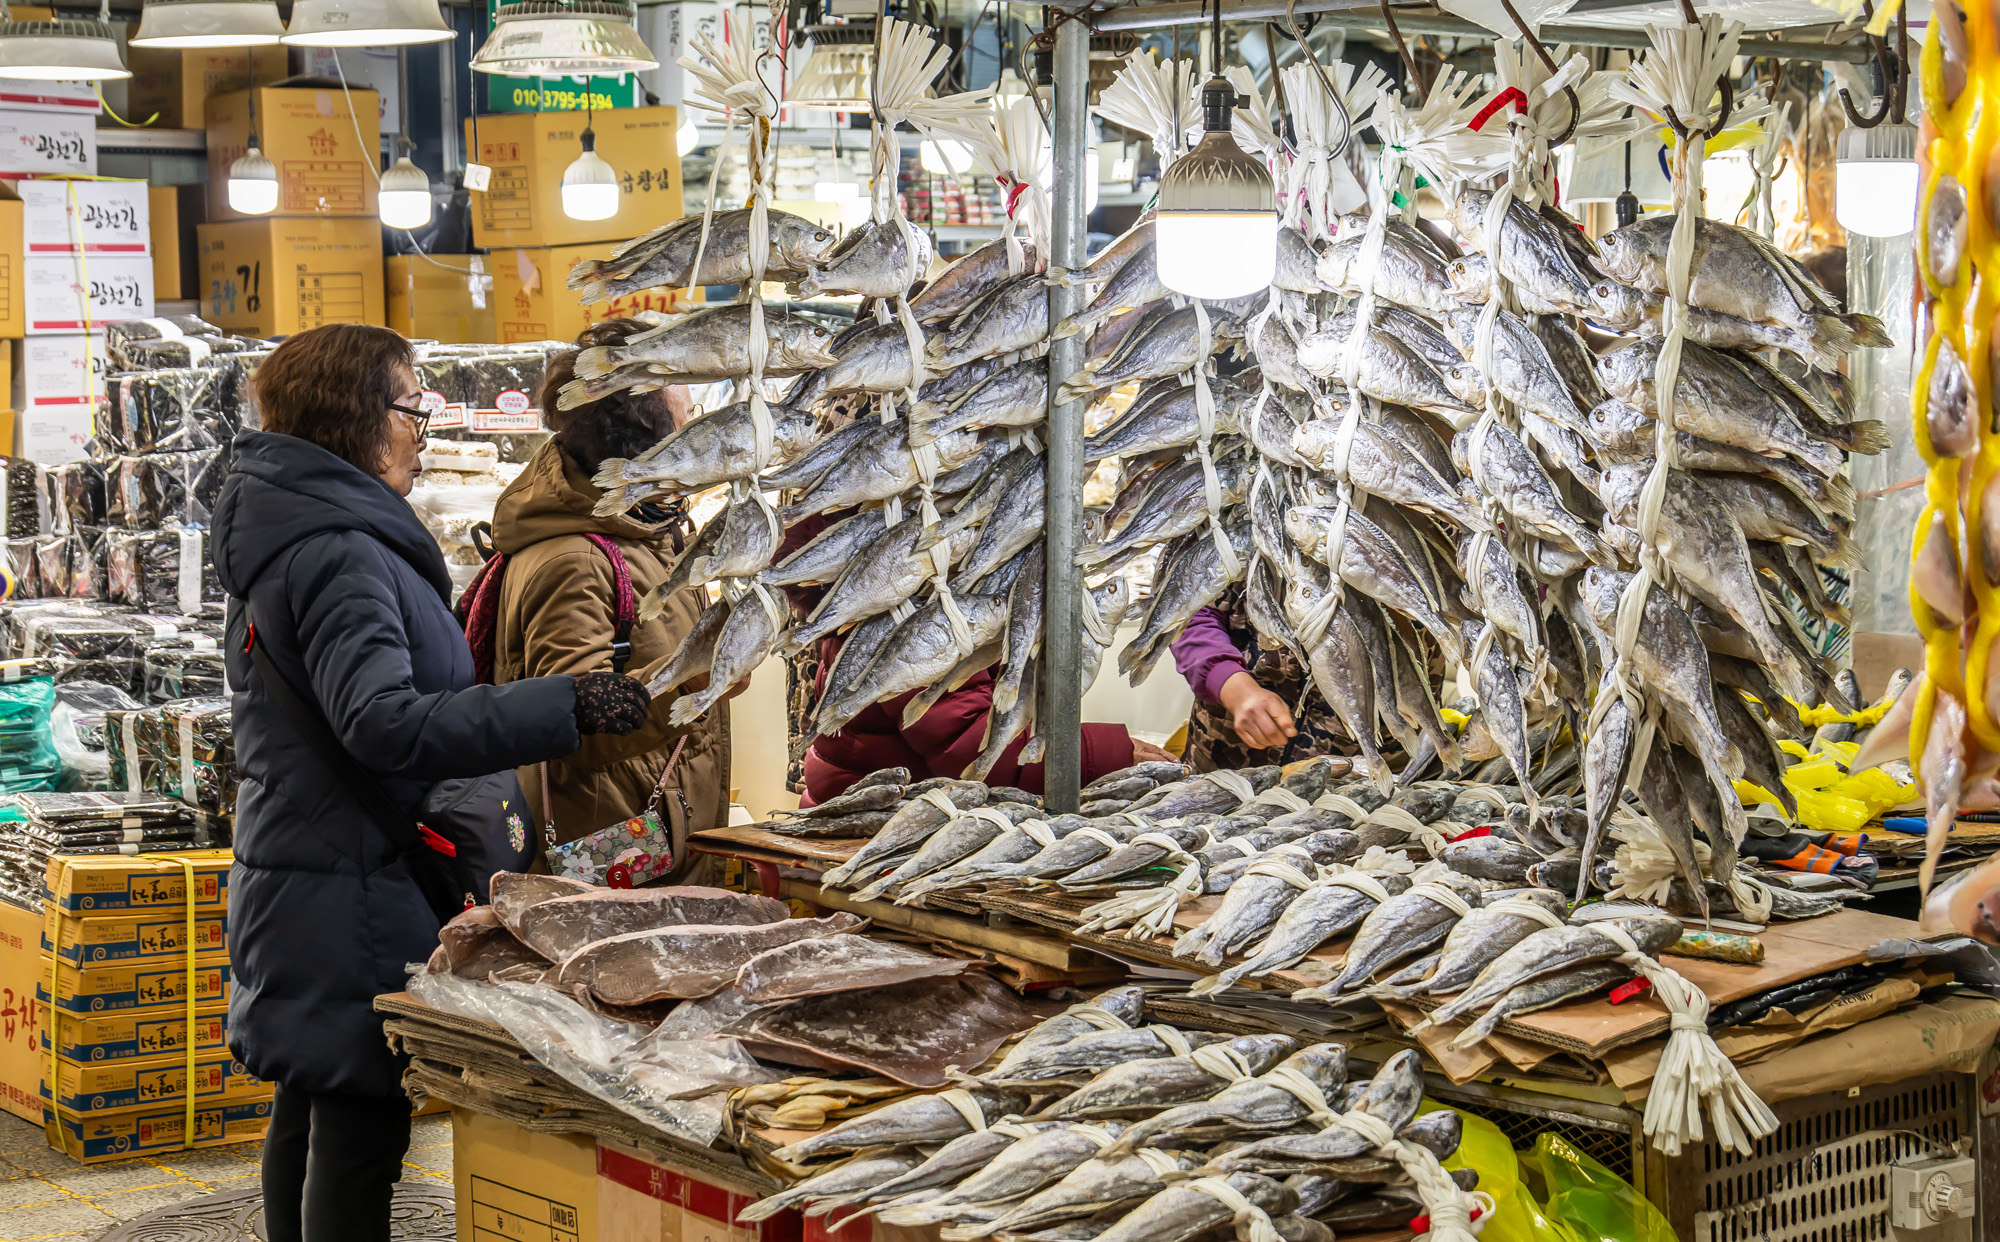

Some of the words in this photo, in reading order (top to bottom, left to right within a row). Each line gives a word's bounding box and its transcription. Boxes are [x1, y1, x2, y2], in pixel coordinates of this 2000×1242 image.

[513, 88, 613, 110] 010-3795-9594
[36, 134, 87, 162] 광천김
[83, 204, 138, 231] 광천김
[88, 281, 143, 307] 광천김
[132, 880, 168, 903] 멸치
[141, 926, 176, 952] 멸치
[140, 977, 175, 1001] 멸치
[1, 988, 42, 1052] 곱창
[141, 1026, 176, 1050] 멸치
[140, 1073, 175, 1098] 멸치
